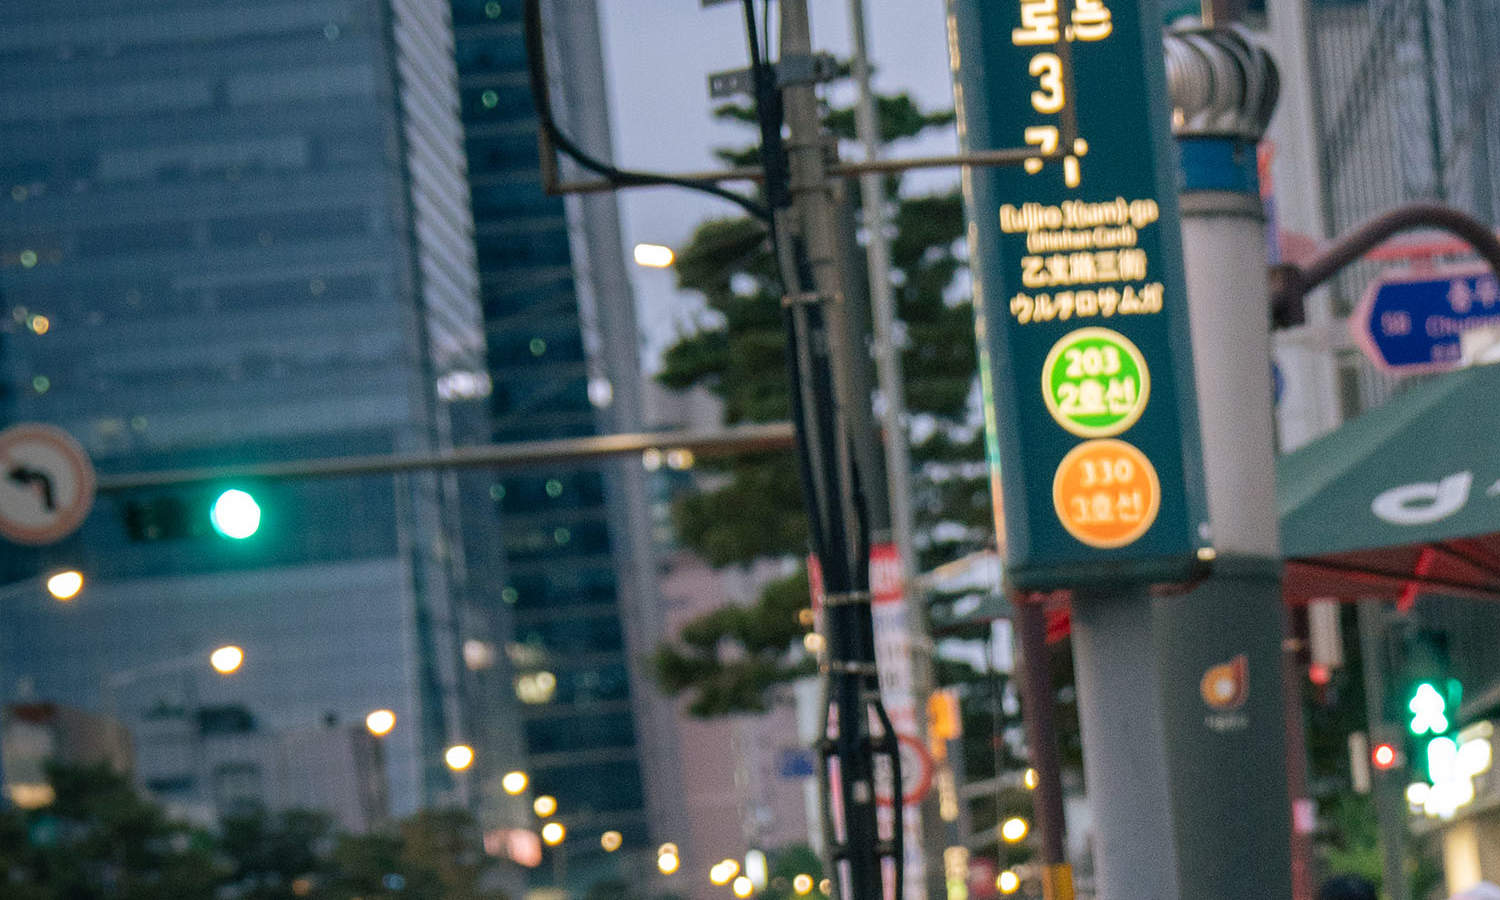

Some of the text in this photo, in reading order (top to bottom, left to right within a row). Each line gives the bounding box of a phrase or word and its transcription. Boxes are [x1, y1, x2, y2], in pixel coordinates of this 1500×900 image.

[1010, 282, 1165, 325] ウルチロサムガ
[1064, 345, 1121, 378] 203
[1057, 375, 1137, 415] 2호선
[1079, 458, 1135, 488] 330
[1070, 490, 1144, 523] 3호선
